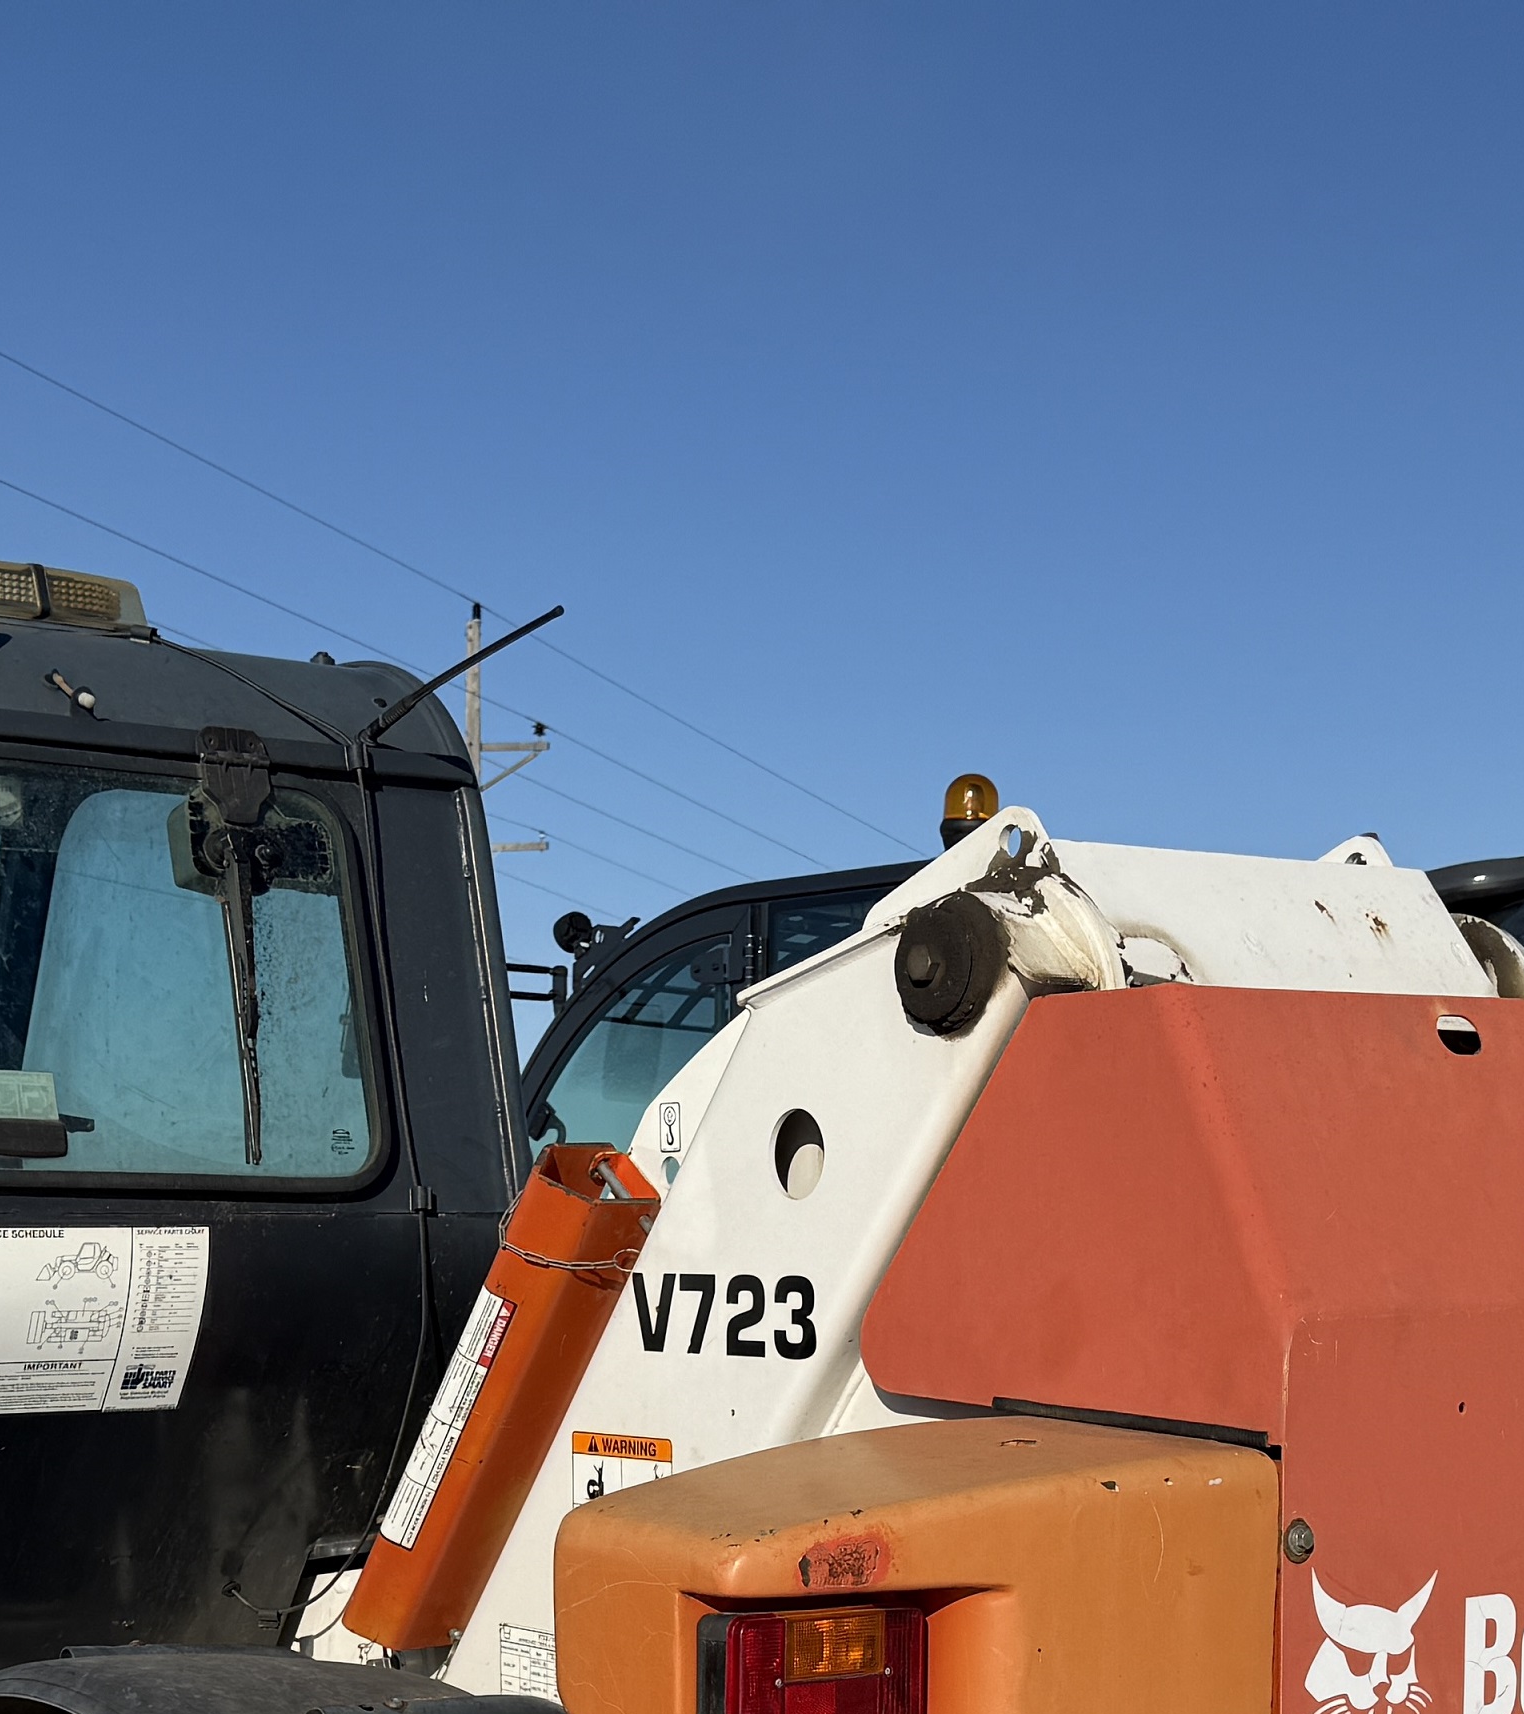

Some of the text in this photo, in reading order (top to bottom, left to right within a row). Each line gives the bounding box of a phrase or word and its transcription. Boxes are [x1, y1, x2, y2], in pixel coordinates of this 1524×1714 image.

[11, 1229, 65, 1239] SCHEDULE
[632, 1273, 818, 1360] V723
[483, 1317, 508, 1359] DANGER
[23, 1362, 83, 1371] IMPORTANT
[601, 1437, 657, 1457] WARNING
